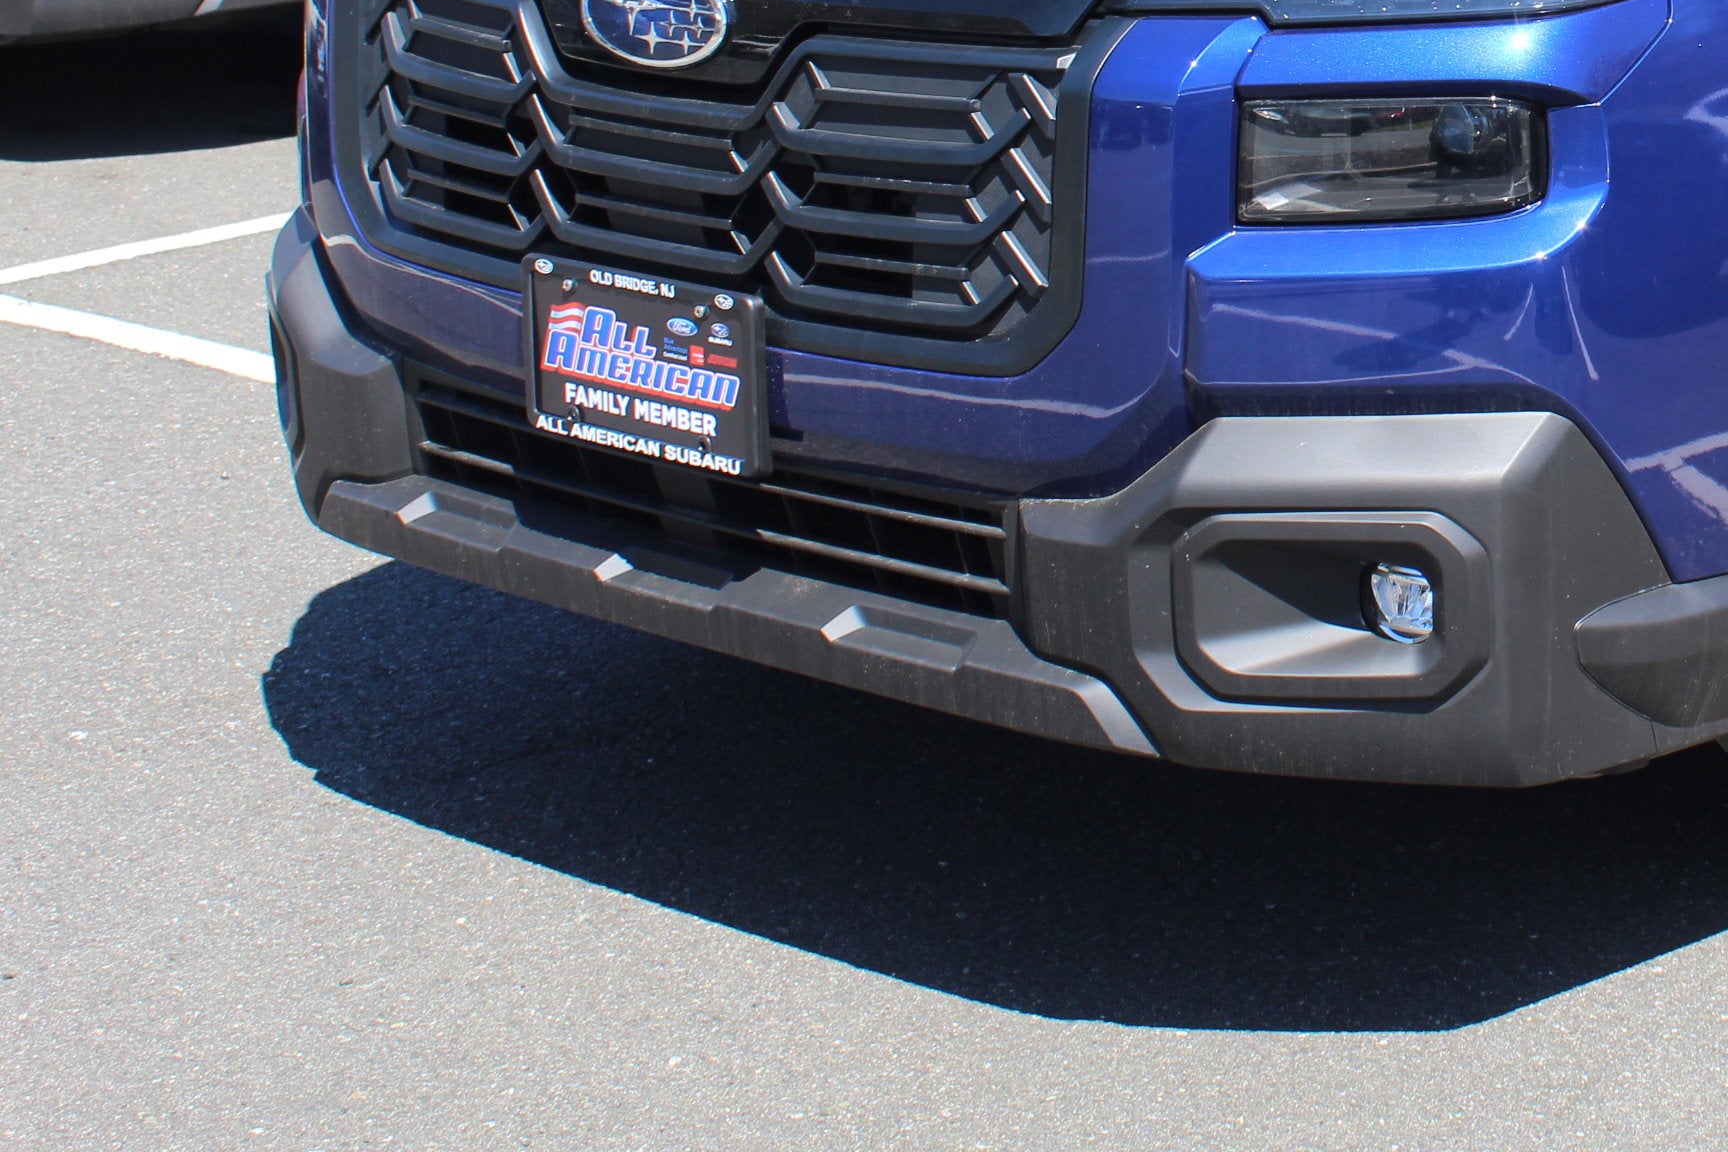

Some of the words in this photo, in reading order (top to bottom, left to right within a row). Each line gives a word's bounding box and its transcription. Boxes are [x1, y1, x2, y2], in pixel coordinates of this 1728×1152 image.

[589, 269, 611, 284] OLD
[613, 274, 659, 296] BRIDGE,
[660, 282, 676, 299] NJ
[581, 305, 657, 359] ALL
[541, 328, 741, 409] AMERICAN
[564, 382, 630, 417] FAMILY
[633, 398, 717, 437] MEMBER
[535, 414, 570, 436] ALL
[570, 423, 660, 458] AMERICAN
[663, 444, 742, 476] SUBARU
